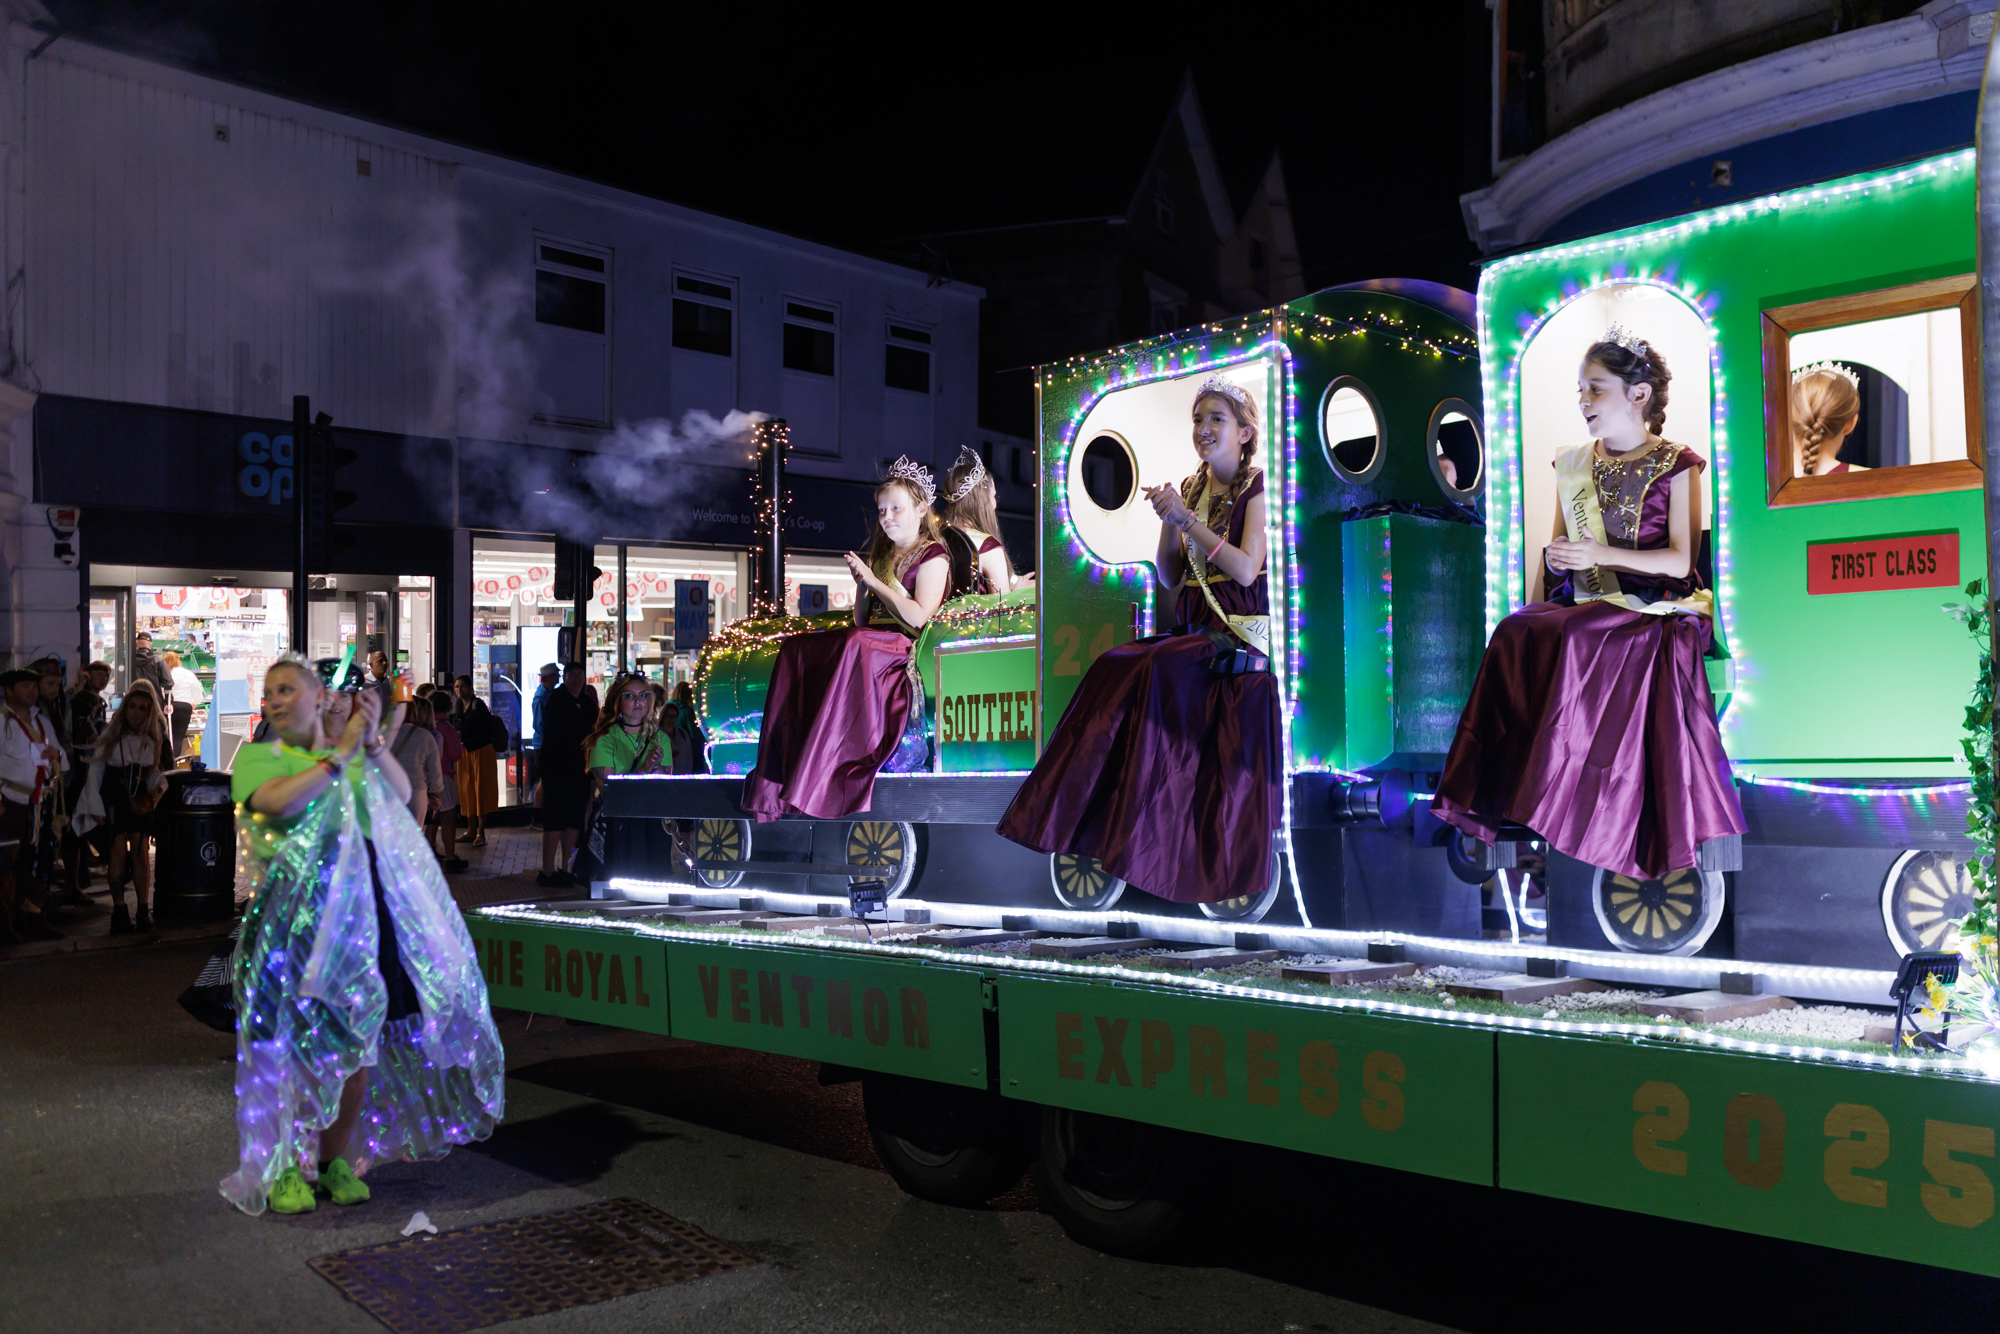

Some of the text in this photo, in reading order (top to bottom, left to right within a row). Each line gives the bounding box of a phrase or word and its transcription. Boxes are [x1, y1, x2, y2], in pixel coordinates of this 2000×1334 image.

[692, 508, 739, 524] Welcome
[741, 515, 750, 525] to
[797, 516, 825, 532] Co-op
[1831, 548, 1937, 580] FIRST CLASS
[680, 586, 703, 606] NO
[677, 610, 706, 631] WAY
[1053, 622, 1115, 677] 24
[544, 944, 650, 1008] ROYAL
[698, 964, 931, 1050] VENTNOR
[1056, 1011, 1407, 1132] EXPRESS
[1633, 1080, 1996, 1229] 2025
